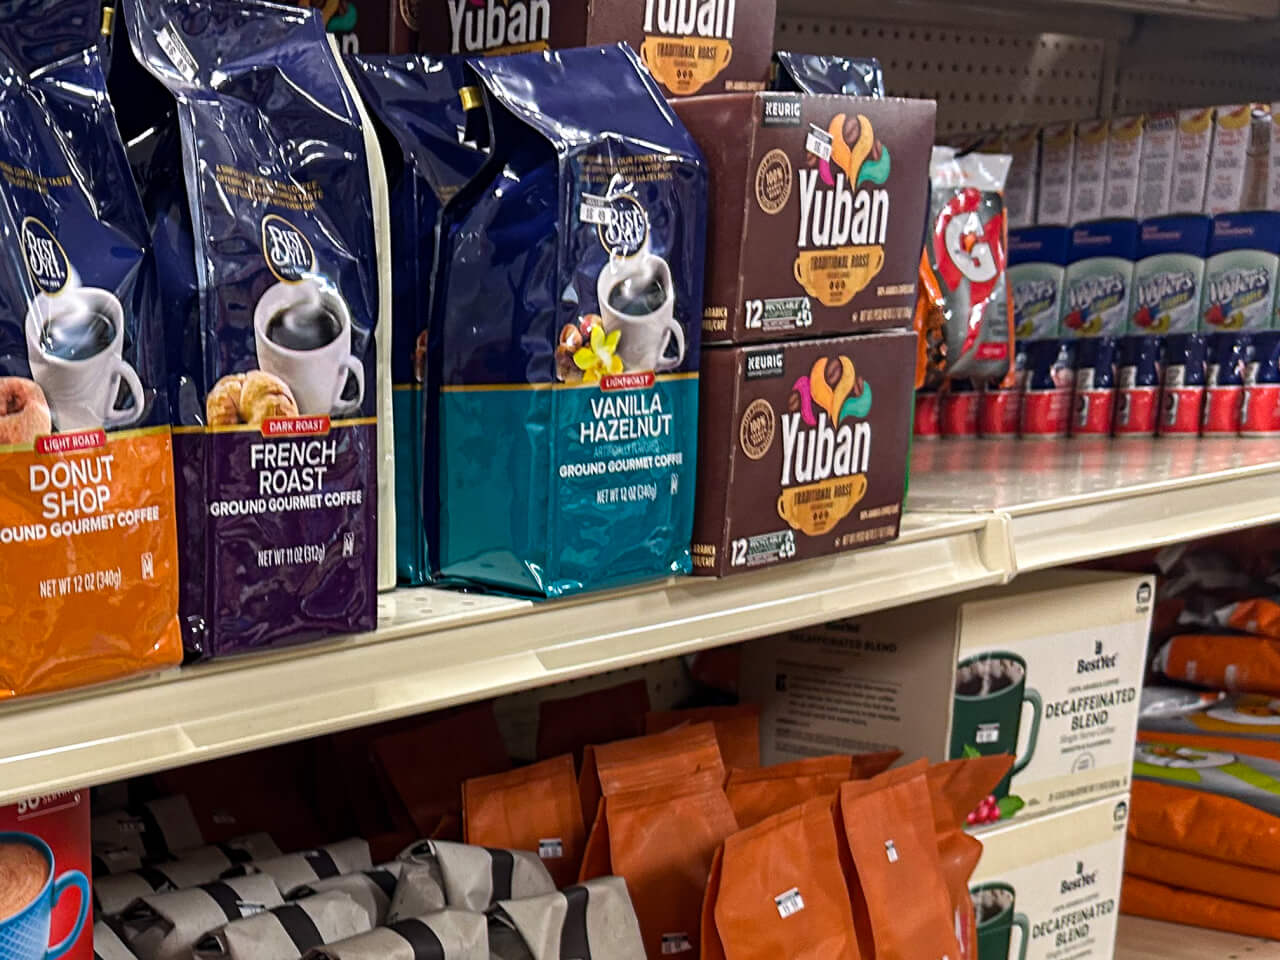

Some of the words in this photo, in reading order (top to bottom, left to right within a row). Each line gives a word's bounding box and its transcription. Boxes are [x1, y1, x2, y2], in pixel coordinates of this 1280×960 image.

[448, 0, 550, 53] Yuban
[765, 101, 801, 117] KEURIG
[797, 168, 890, 247] Yuban
[945, 211, 998, 283] G
[745, 300, 763, 329] 12
[746, 353, 783, 371] KEURIG
[590, 392, 663, 419] VANILLA
[269, 420, 293, 434] DARK
[294, 418, 325, 433] ROAST
[579, 413, 673, 445] HAZELNUT
[43, 435, 70, 453] LIGHT
[72, 432, 100, 450] ROAST
[250, 439, 337, 469] FRENCH
[781, 412, 871, 485] Yuban
[28, 455, 115, 493] DONUT
[258, 466, 329, 495] ROAST
[559, 462, 607, 479] GROUND
[607, 456, 653, 473] GOURMET
[41, 485, 111, 521] SHOP
[209, 499, 267, 518] GROUND
[268, 494, 323, 514] GOURMET
[324, 489, 363, 507] COFFEE
[49, 513, 116, 537] GOURMET
[117, 504, 160, 526] COFFEE
[257, 549, 273, 568] NET
[273, 547, 285, 566] WT
[730, 539, 748, 567] 12
[39, 578, 57, 599] NET
[58, 576, 71, 597] WT
[72, 574, 83, 593] 12
[84, 572, 95, 592] OZ
[96, 566, 122, 592] (340g)
[1045, 687, 1137, 719] DECAFFEINATED
[1071, 711, 1109, 731] BLEND
[1032, 899, 1115, 940] DECAFFEINATED
[1055, 924, 1089, 949] BLEND
